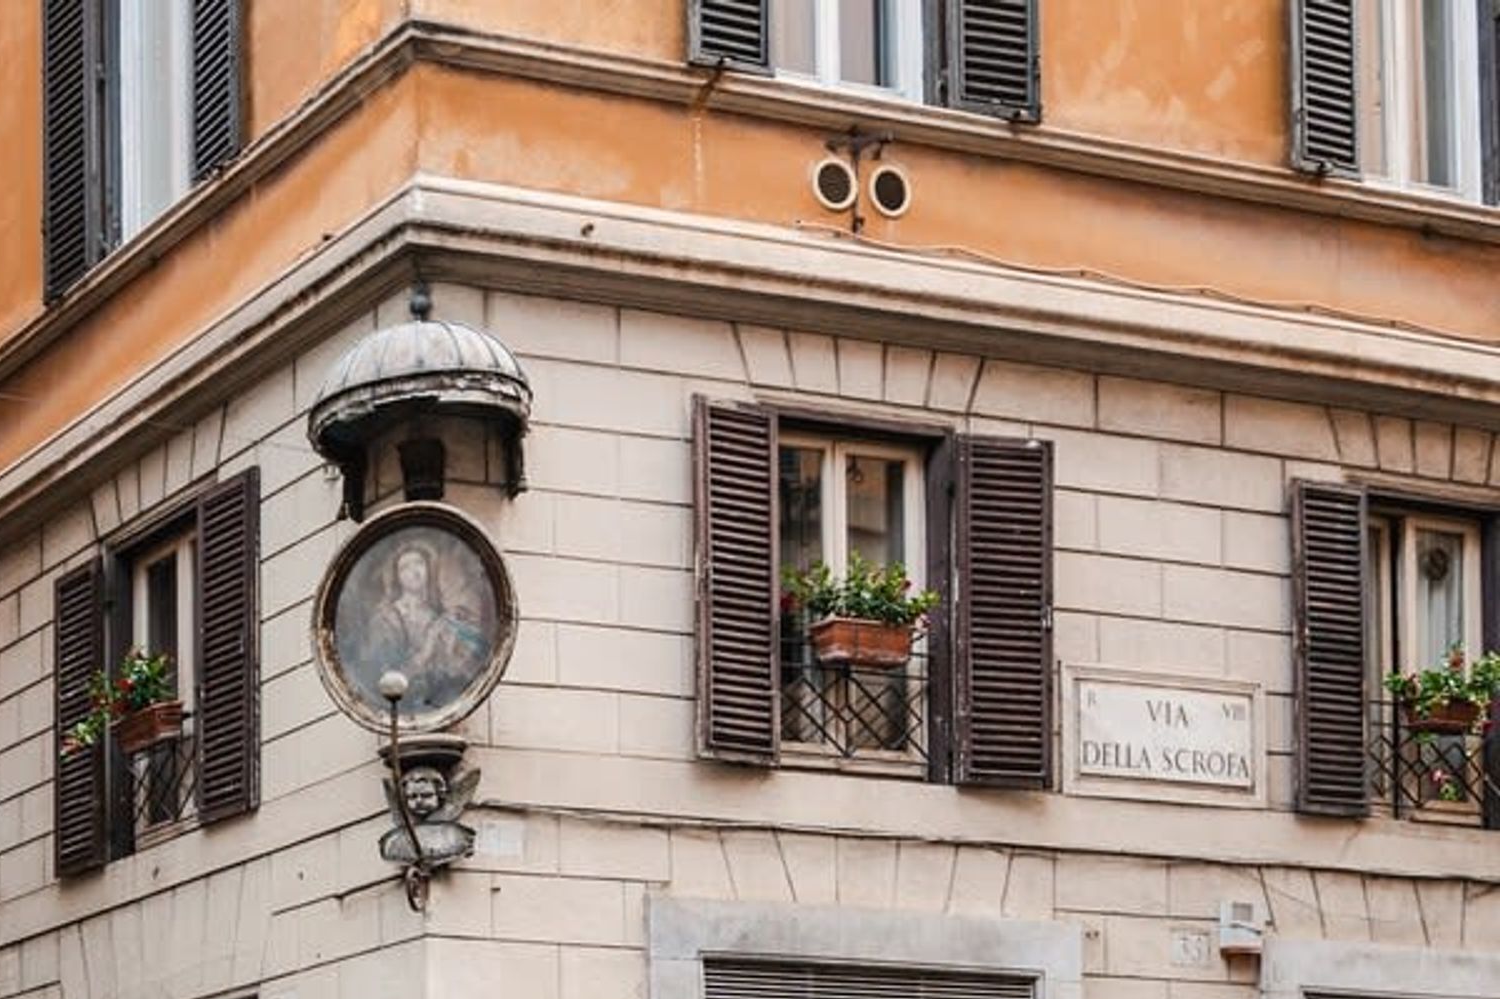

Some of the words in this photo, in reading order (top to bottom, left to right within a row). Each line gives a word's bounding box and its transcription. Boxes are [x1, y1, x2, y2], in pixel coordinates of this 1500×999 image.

[1146, 699, 1189, 728] VIA
[1082, 740, 1151, 771] DELLA
[1162, 746, 1249, 779] SCROFA
